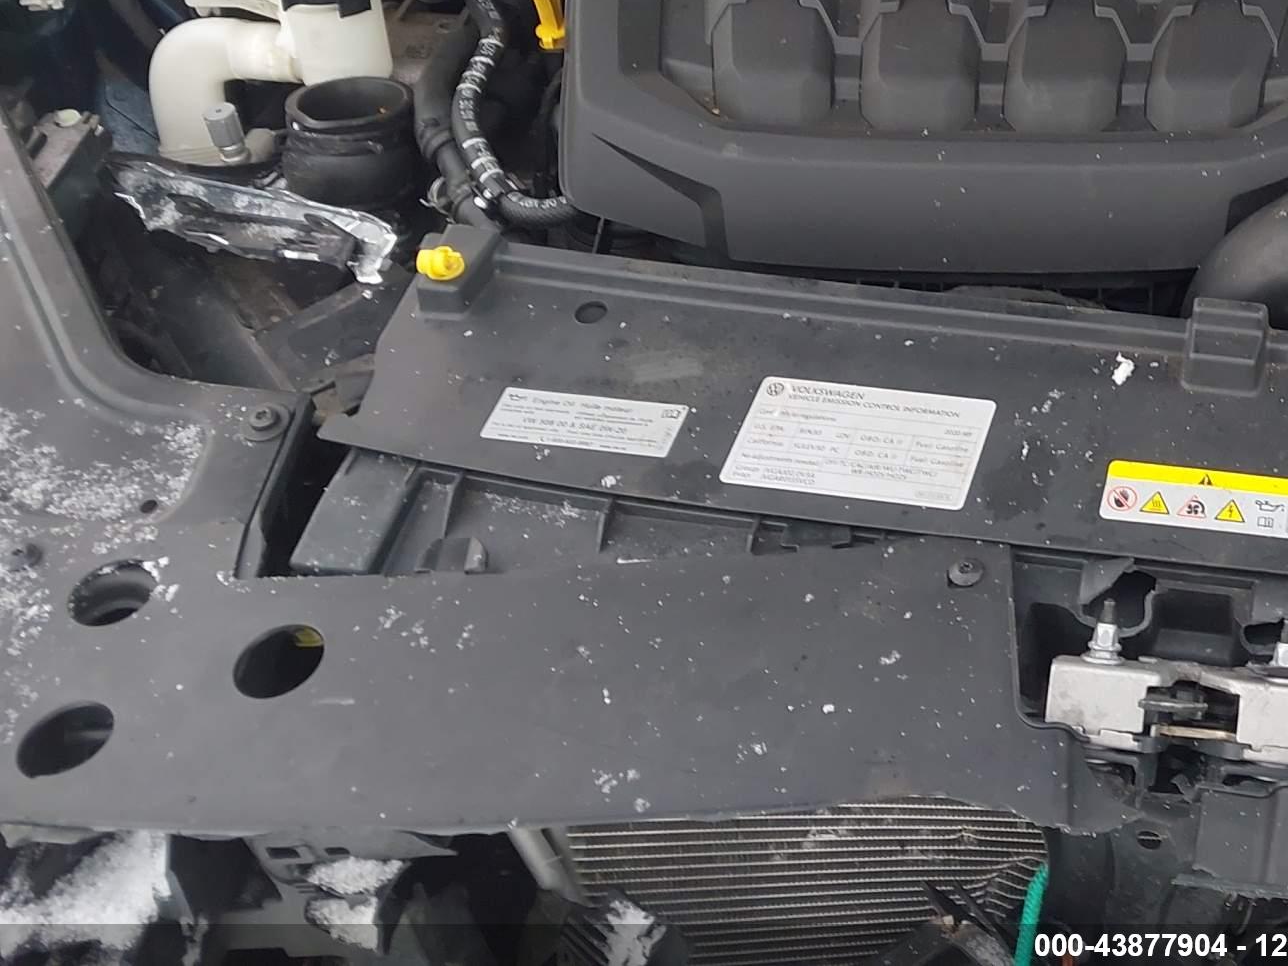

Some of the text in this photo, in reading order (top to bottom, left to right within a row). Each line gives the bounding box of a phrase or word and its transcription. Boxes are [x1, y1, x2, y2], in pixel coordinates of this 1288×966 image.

[790, 385, 865, 400] VOLKSWAGEN
[821, 397, 862, 408] EMISSION
[863, 400, 901, 412] CONTROL
[903, 405, 960, 418] INFORMATION
